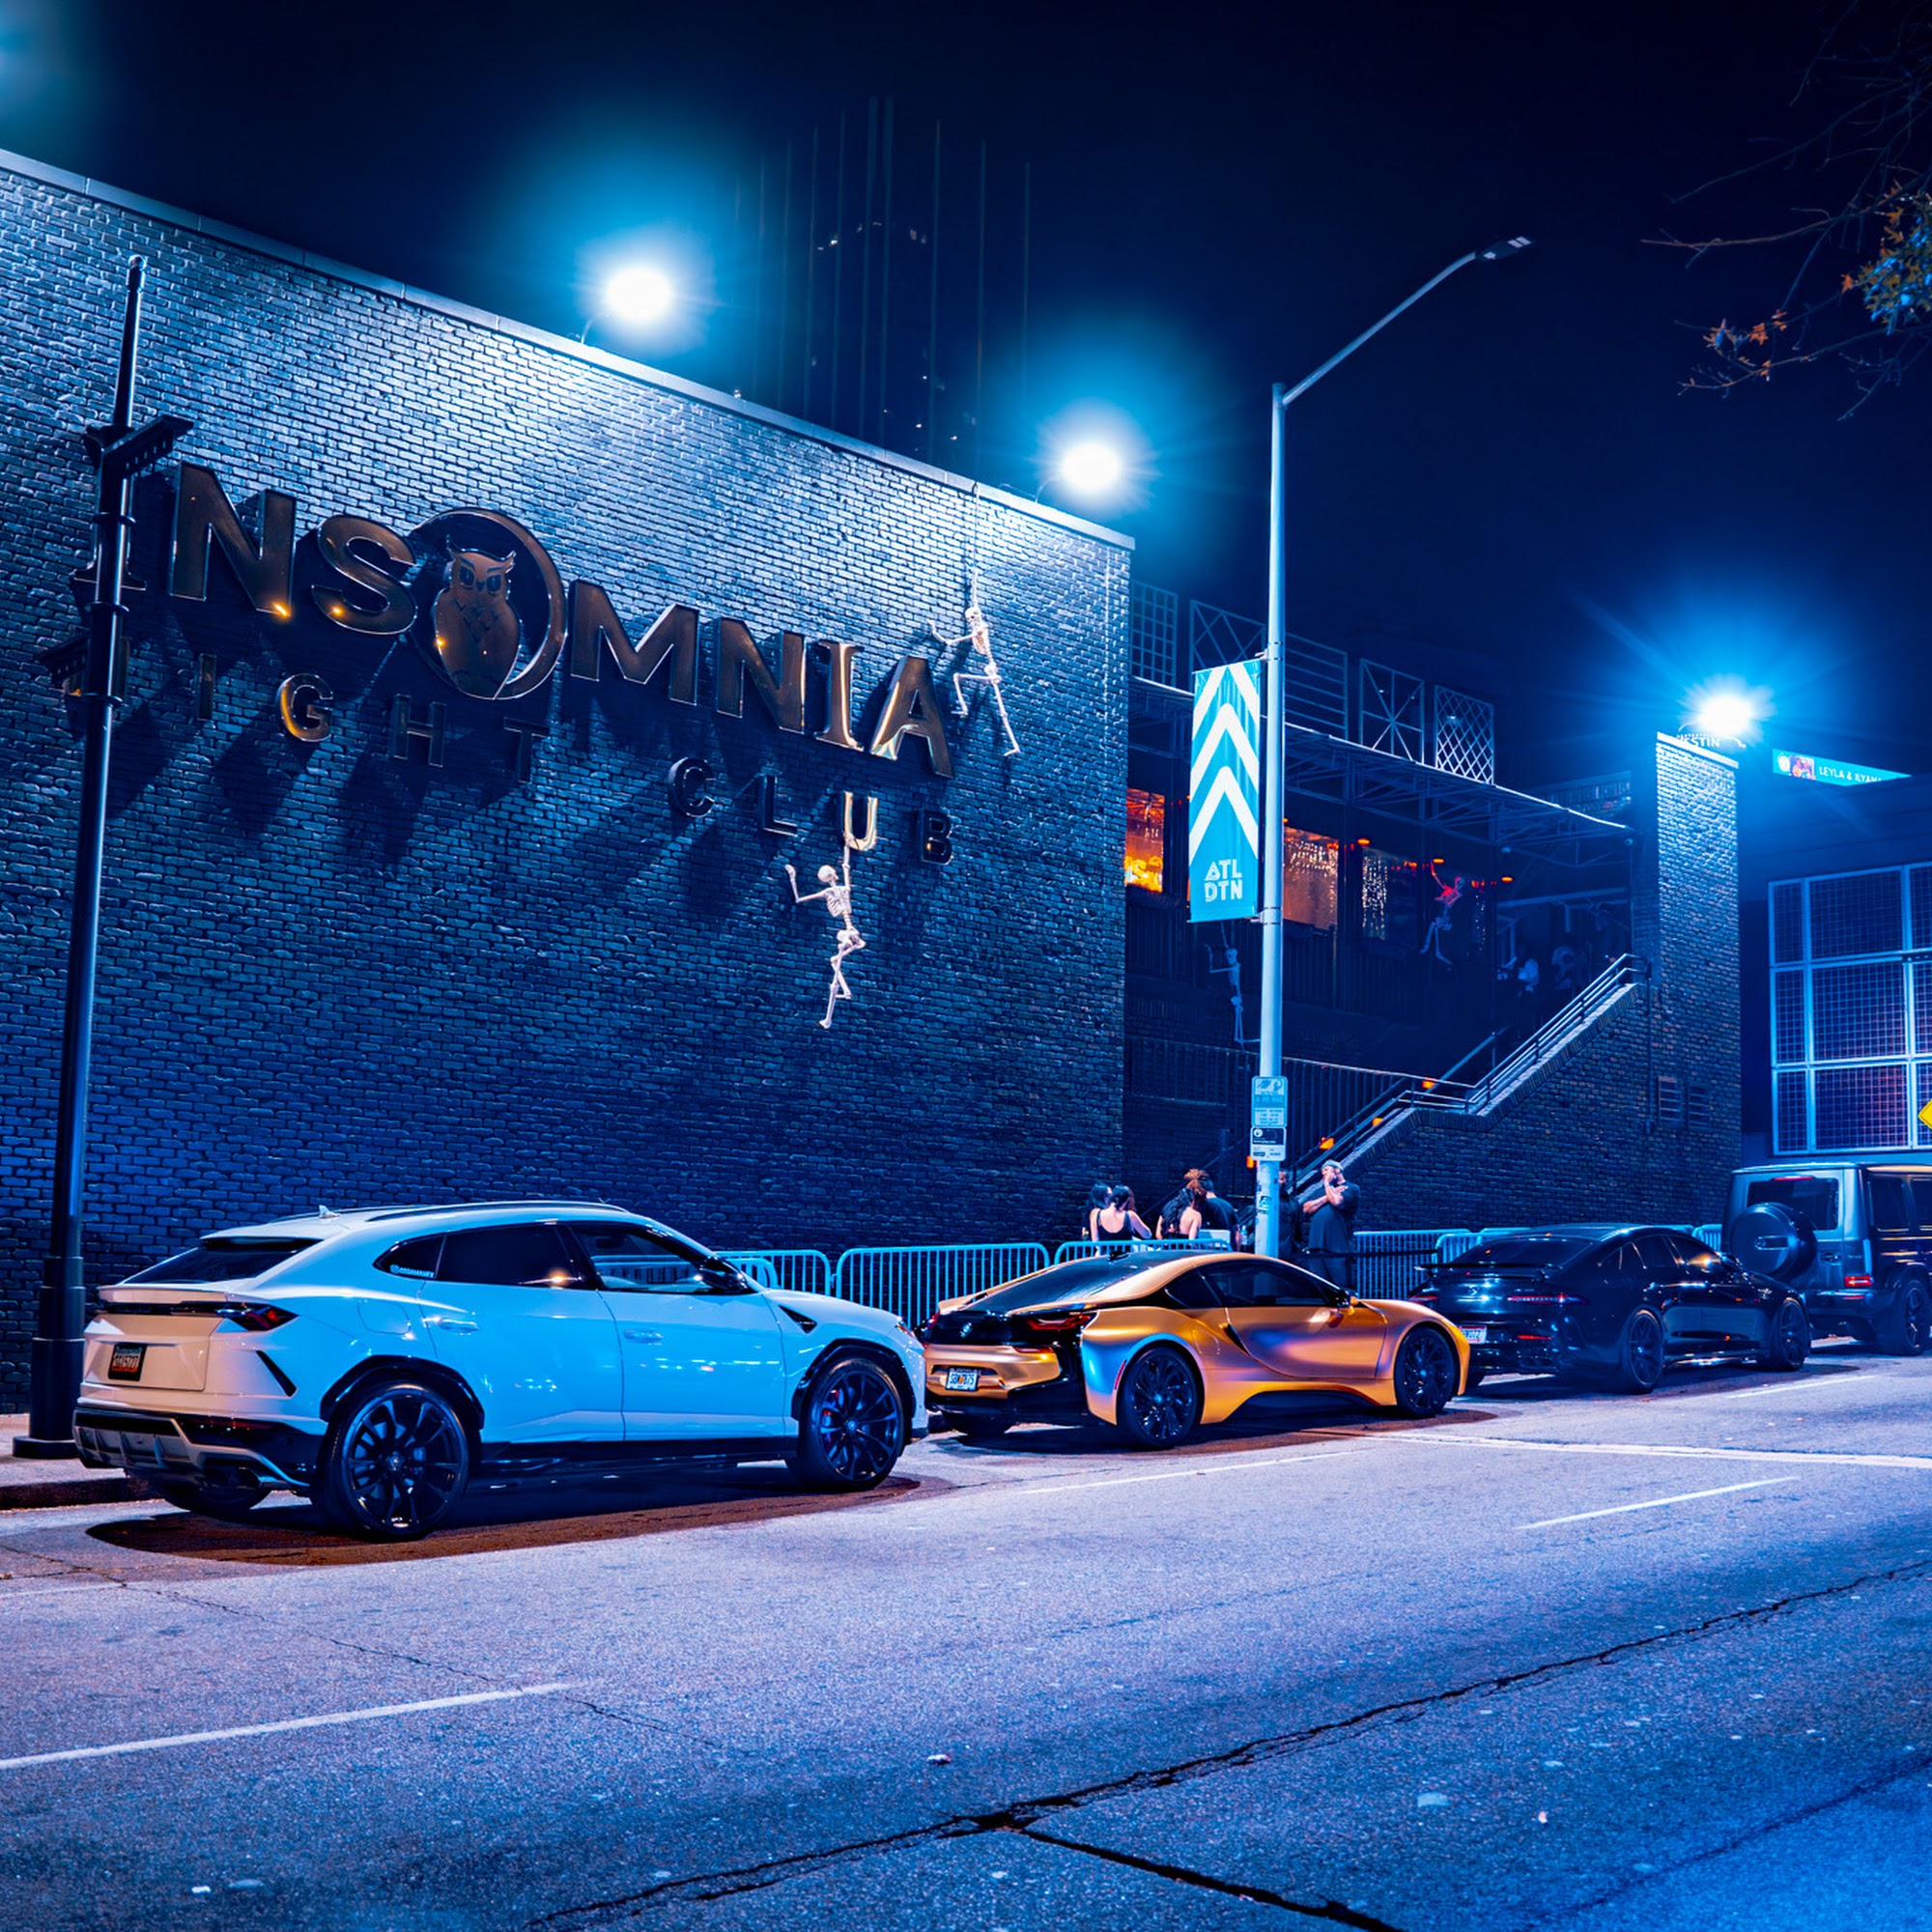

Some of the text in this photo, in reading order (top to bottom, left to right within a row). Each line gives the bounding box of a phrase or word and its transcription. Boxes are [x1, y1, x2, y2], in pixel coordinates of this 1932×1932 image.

[1818, 766, 1845, 779] LEYLA
[1846, 771, 1853, 781] &
[667, 755, 954, 866] CLUB
[1204, 859, 1242, 881] ATL
[1204, 879, 1243, 902] DTN
